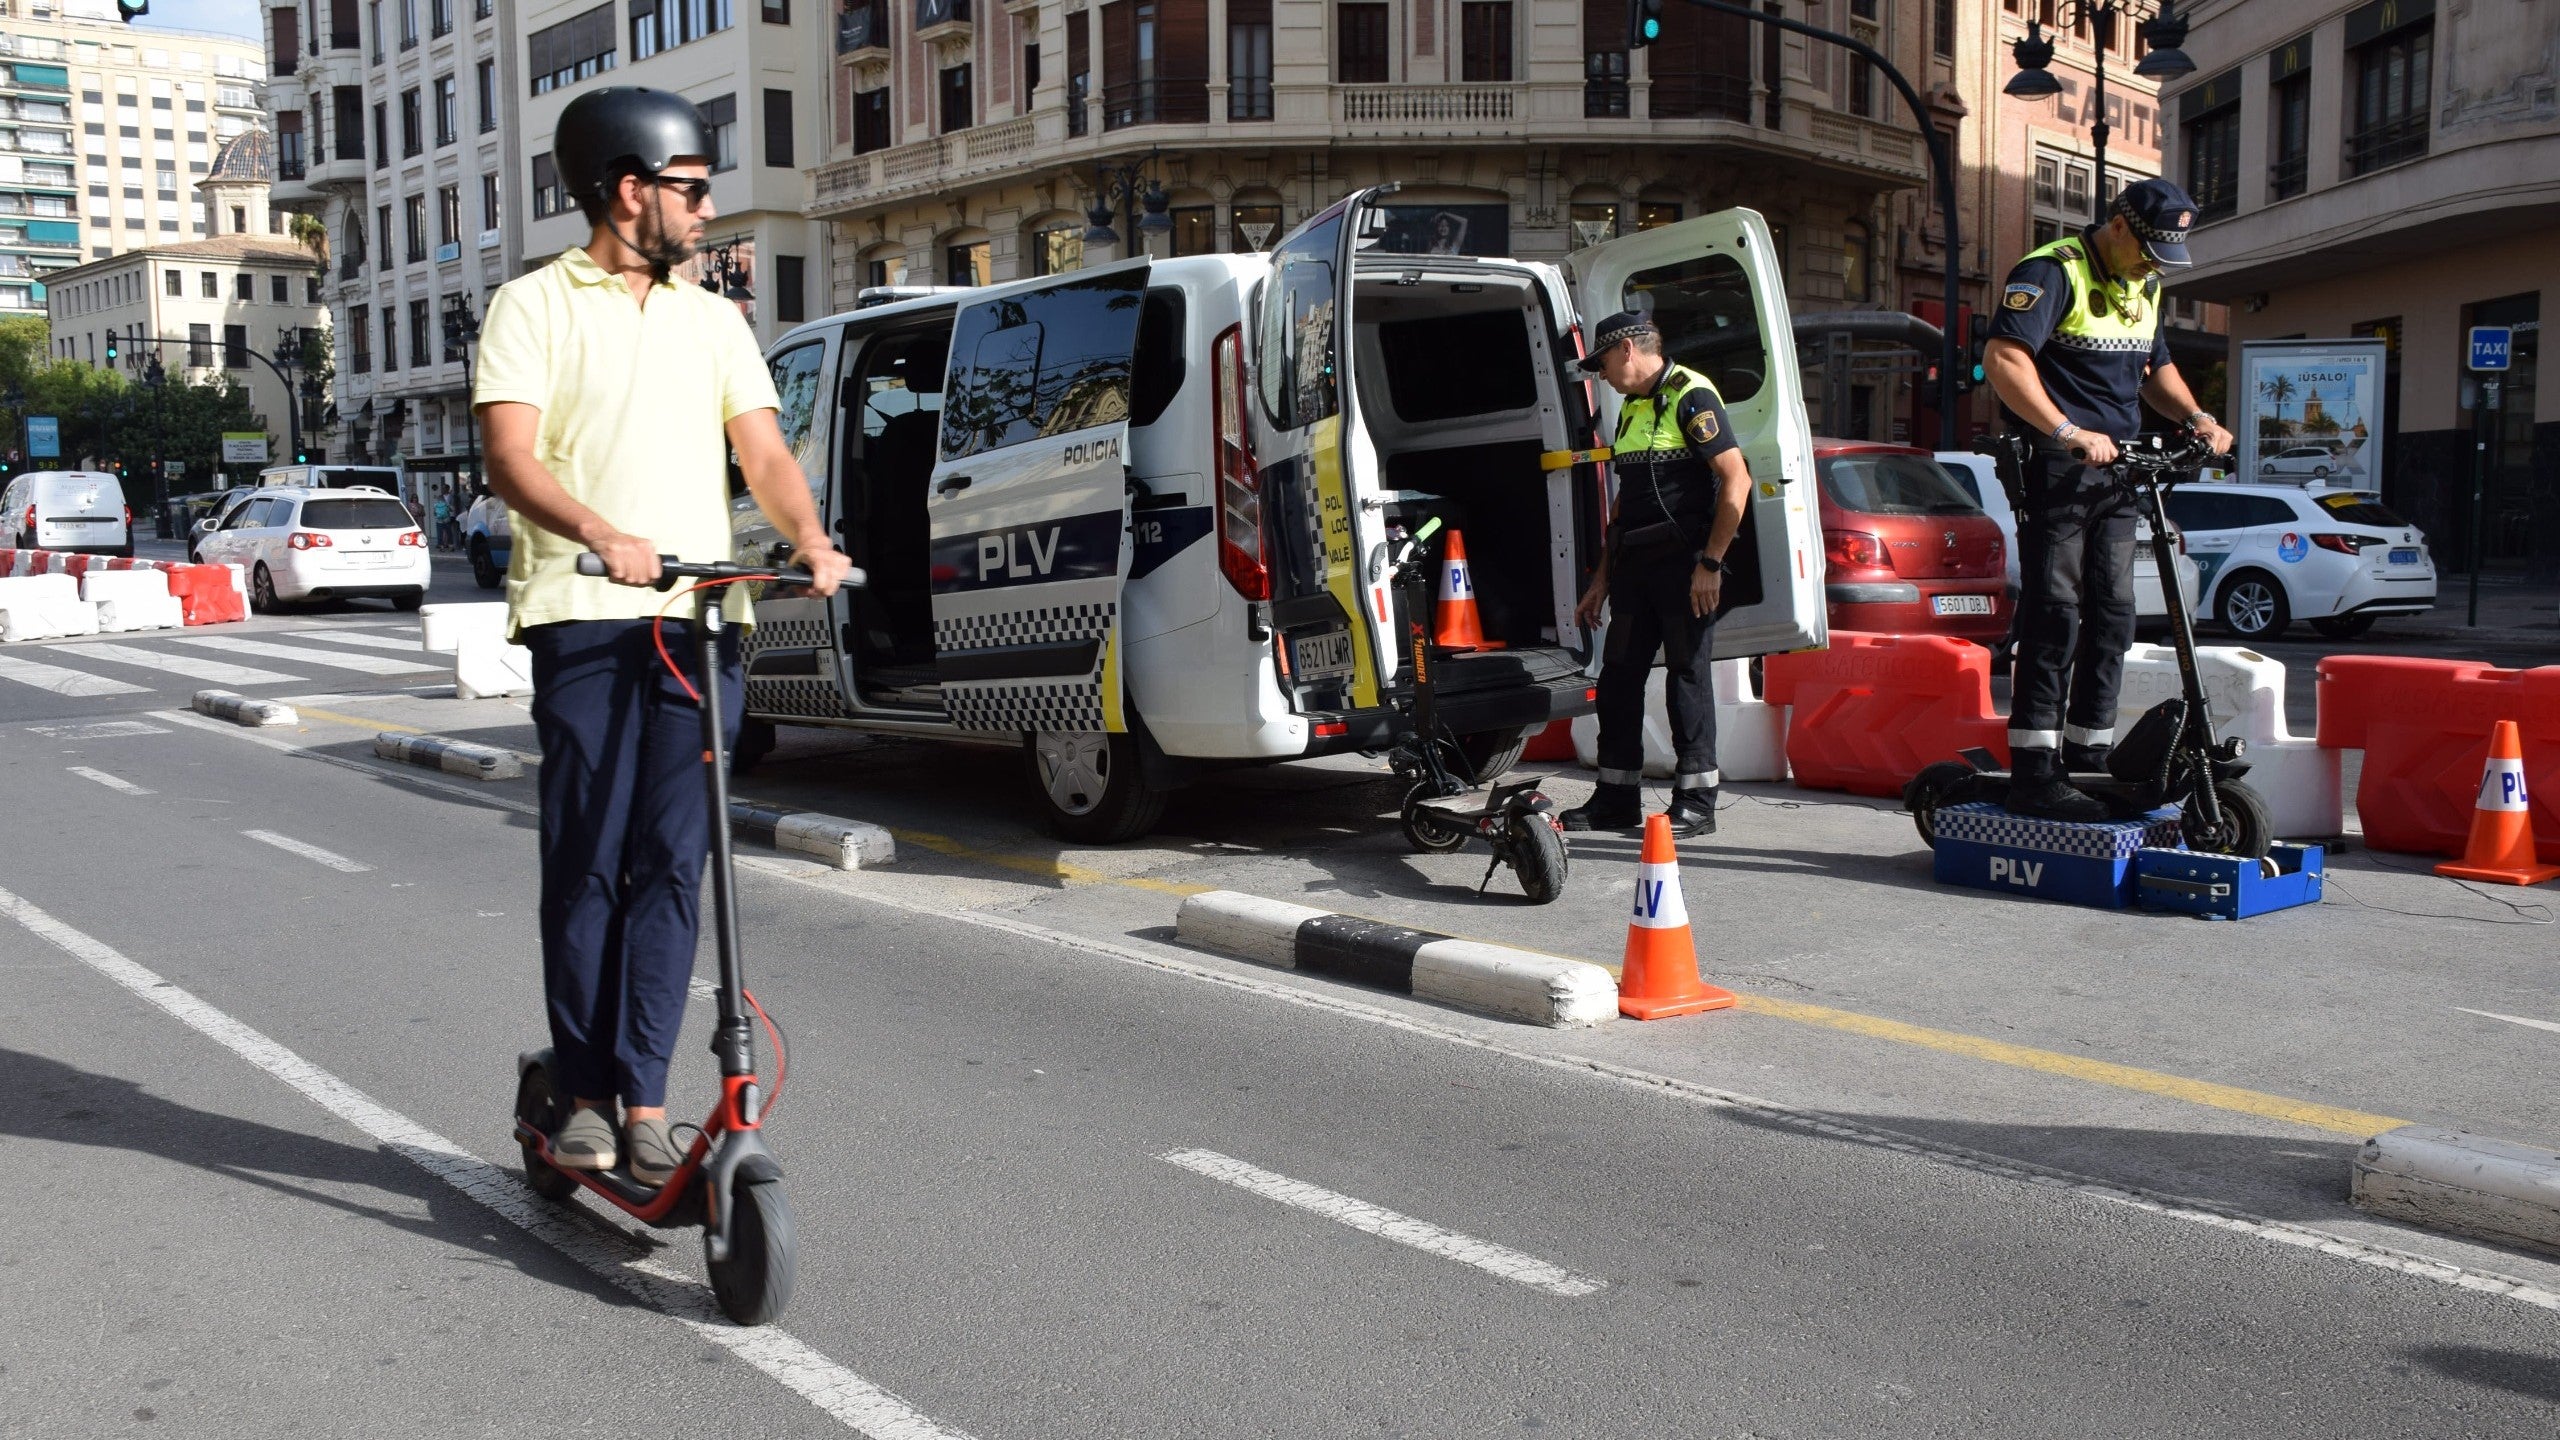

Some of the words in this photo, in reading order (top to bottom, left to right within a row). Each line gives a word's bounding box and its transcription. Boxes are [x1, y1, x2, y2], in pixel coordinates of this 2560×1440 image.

[2473, 342, 2508, 355] TAXI
[2298, 371, 2348, 382] ¡ÚSALO!
[1063, 437, 1119, 467] POLICIA
[1325, 495, 1342, 512] POL
[1132, 521, 1163, 545] 112
[1331, 517, 1349, 534] LOC
[978, 526, 1062, 582] PLV
[1940, 598, 1967, 612] 5601
[1969, 598, 1987, 612] DBJ
[1299, 640, 1325, 669] 6521
[1990, 856, 2043, 887] PLV
